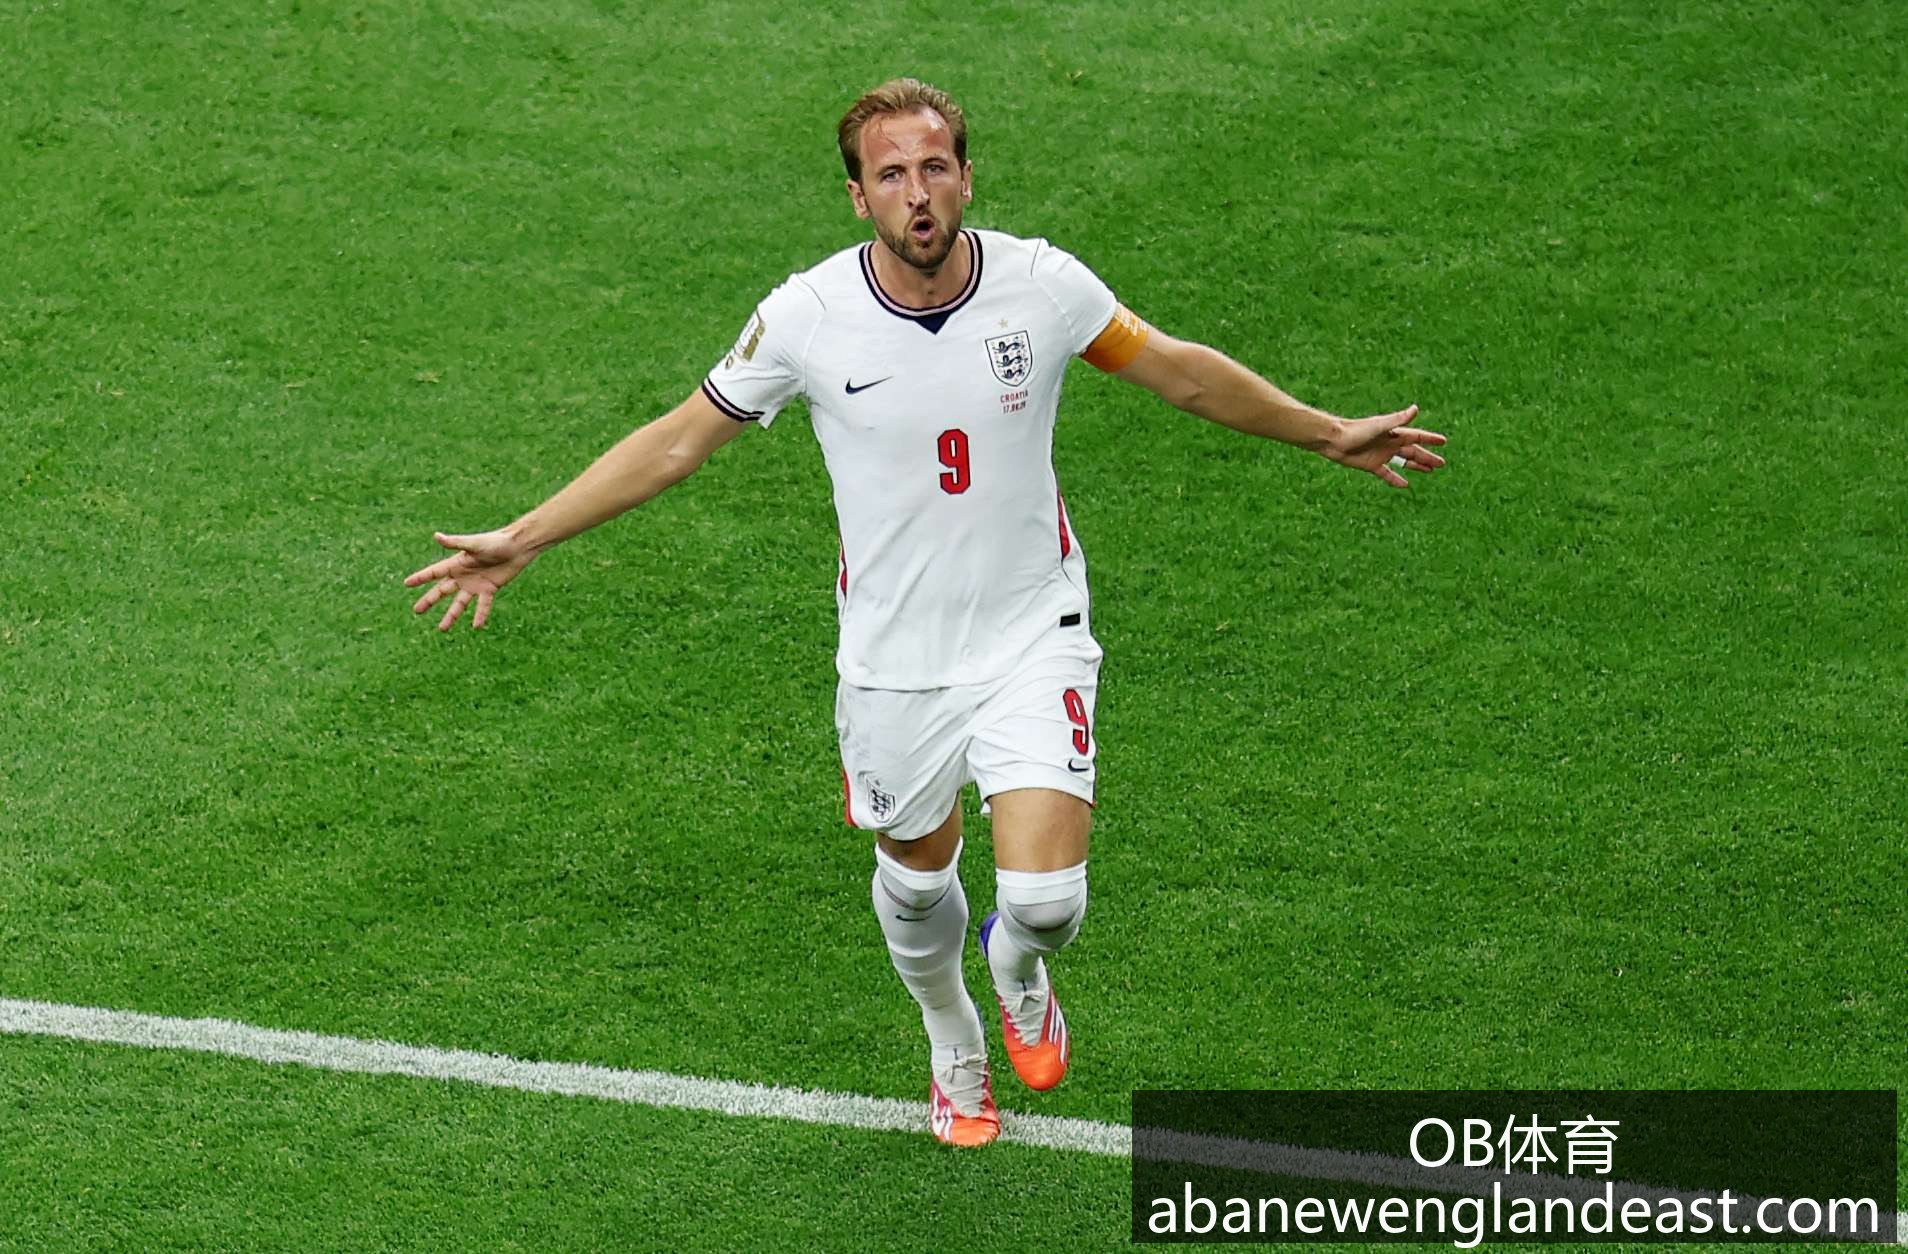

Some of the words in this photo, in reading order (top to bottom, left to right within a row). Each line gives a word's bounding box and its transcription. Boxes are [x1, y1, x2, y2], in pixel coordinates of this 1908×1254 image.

[1000, 389, 1029, 403] CROATIA
[937, 428, 971, 495] 9
[1062, 688, 1090, 756] 9
